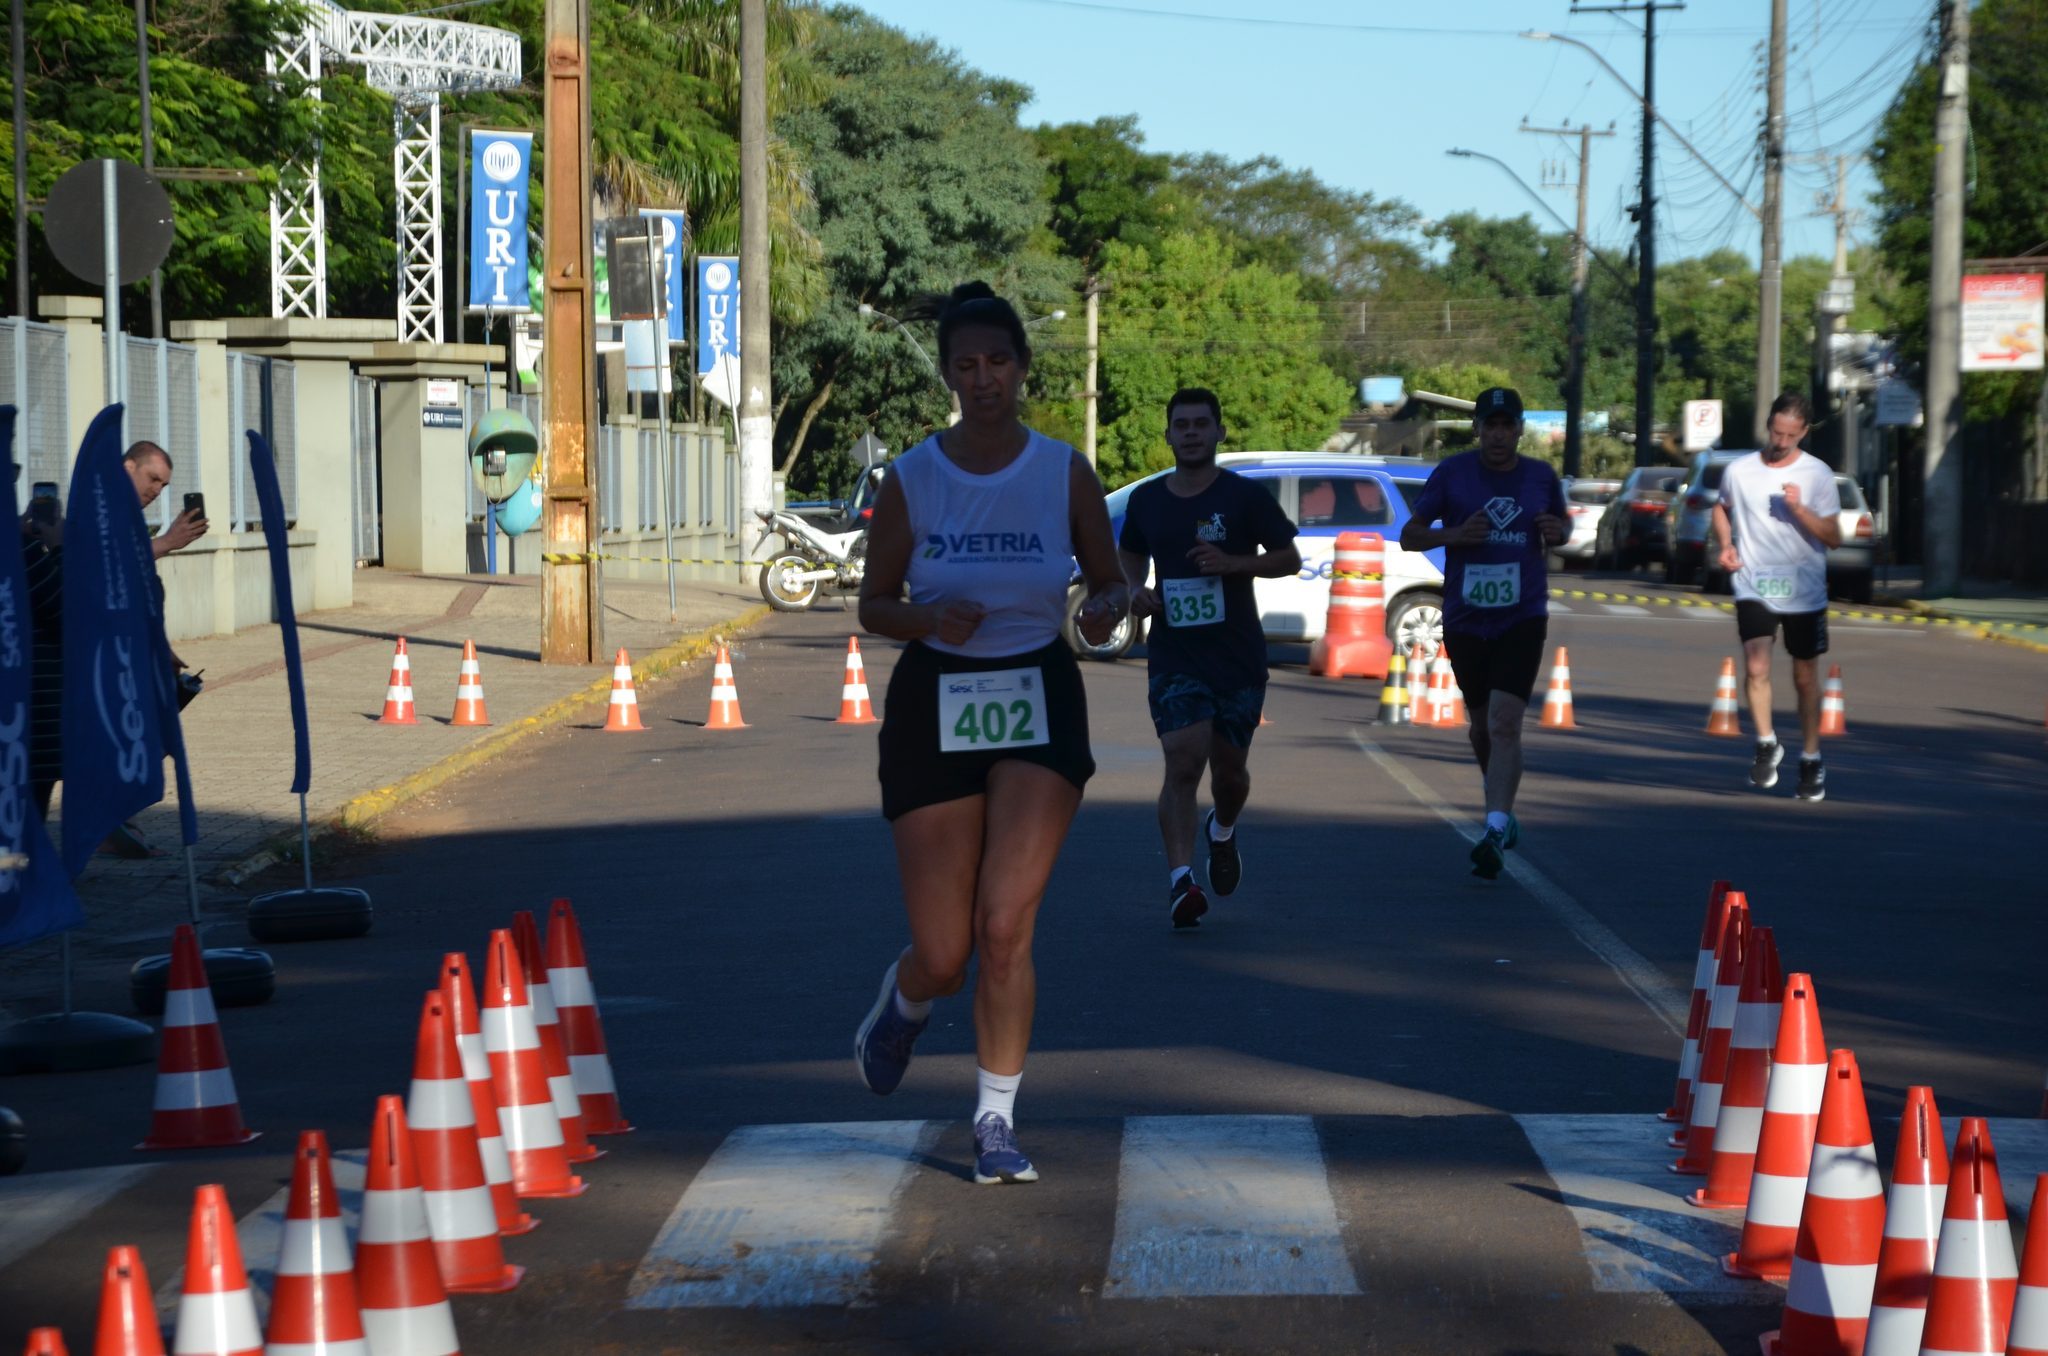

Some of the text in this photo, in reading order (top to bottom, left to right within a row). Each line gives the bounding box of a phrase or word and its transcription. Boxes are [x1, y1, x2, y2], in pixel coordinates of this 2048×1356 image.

[485, 189, 518, 303] URI
[430, 412, 444, 424] URI
[948, 533, 1045, 553] VETRIA
[1488, 530, 1528, 543] RAMS
[1470, 580, 1513, 604] 403
[1757, 578, 1792, 596] 566
[1170, 594, 1217, 622] 335
[954, 699, 1035, 743] 402
